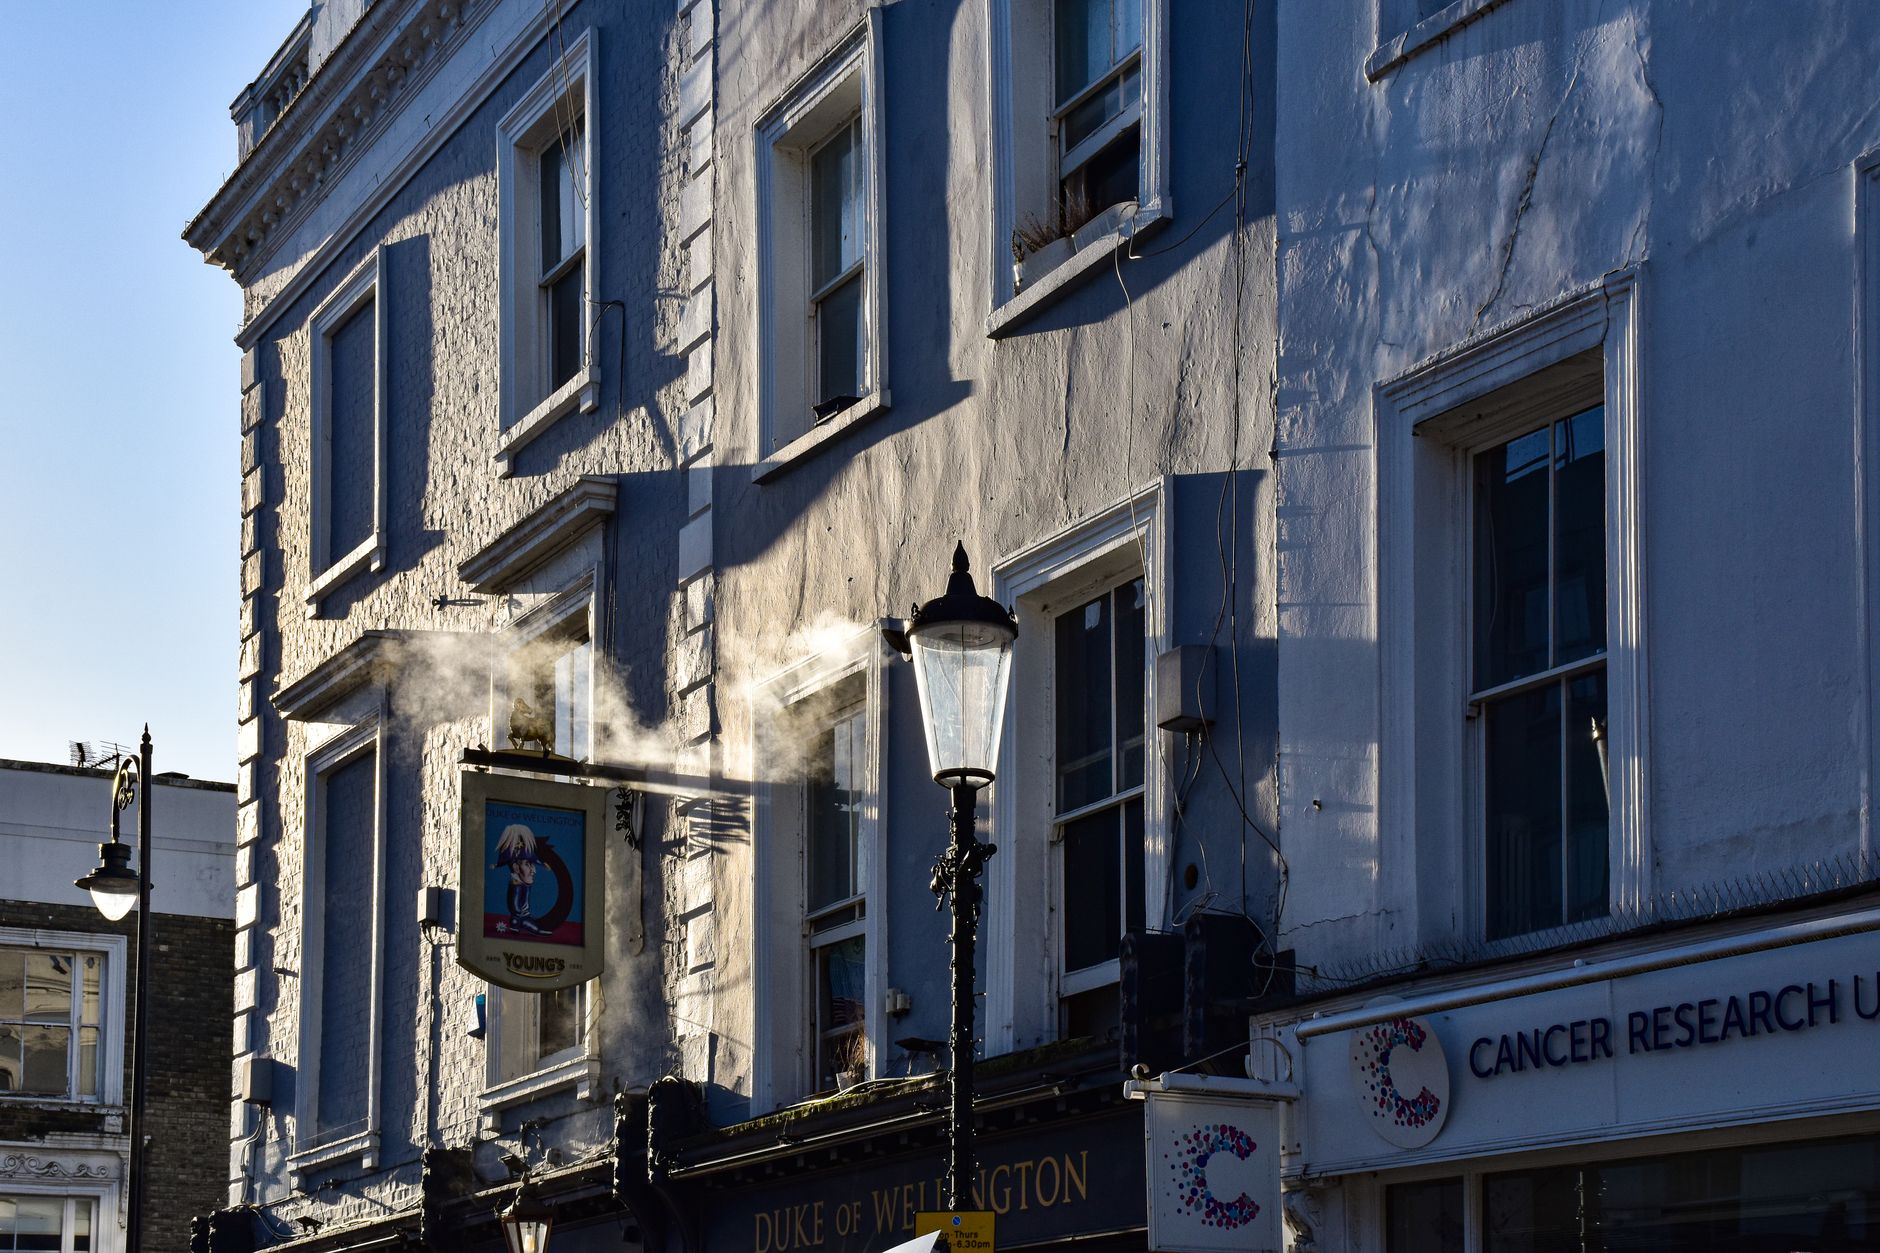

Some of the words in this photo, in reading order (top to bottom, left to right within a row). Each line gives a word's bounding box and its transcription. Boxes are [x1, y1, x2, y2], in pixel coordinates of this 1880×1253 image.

[1469, 1017, 1613, 1079] CANCER
[1628, 979, 1836, 1054] RESEARCH
[754, 1200, 825, 1253] DUKE
[835, 1201, 862, 1236] OF
[871, 1150, 1089, 1234] WELLNGTON
